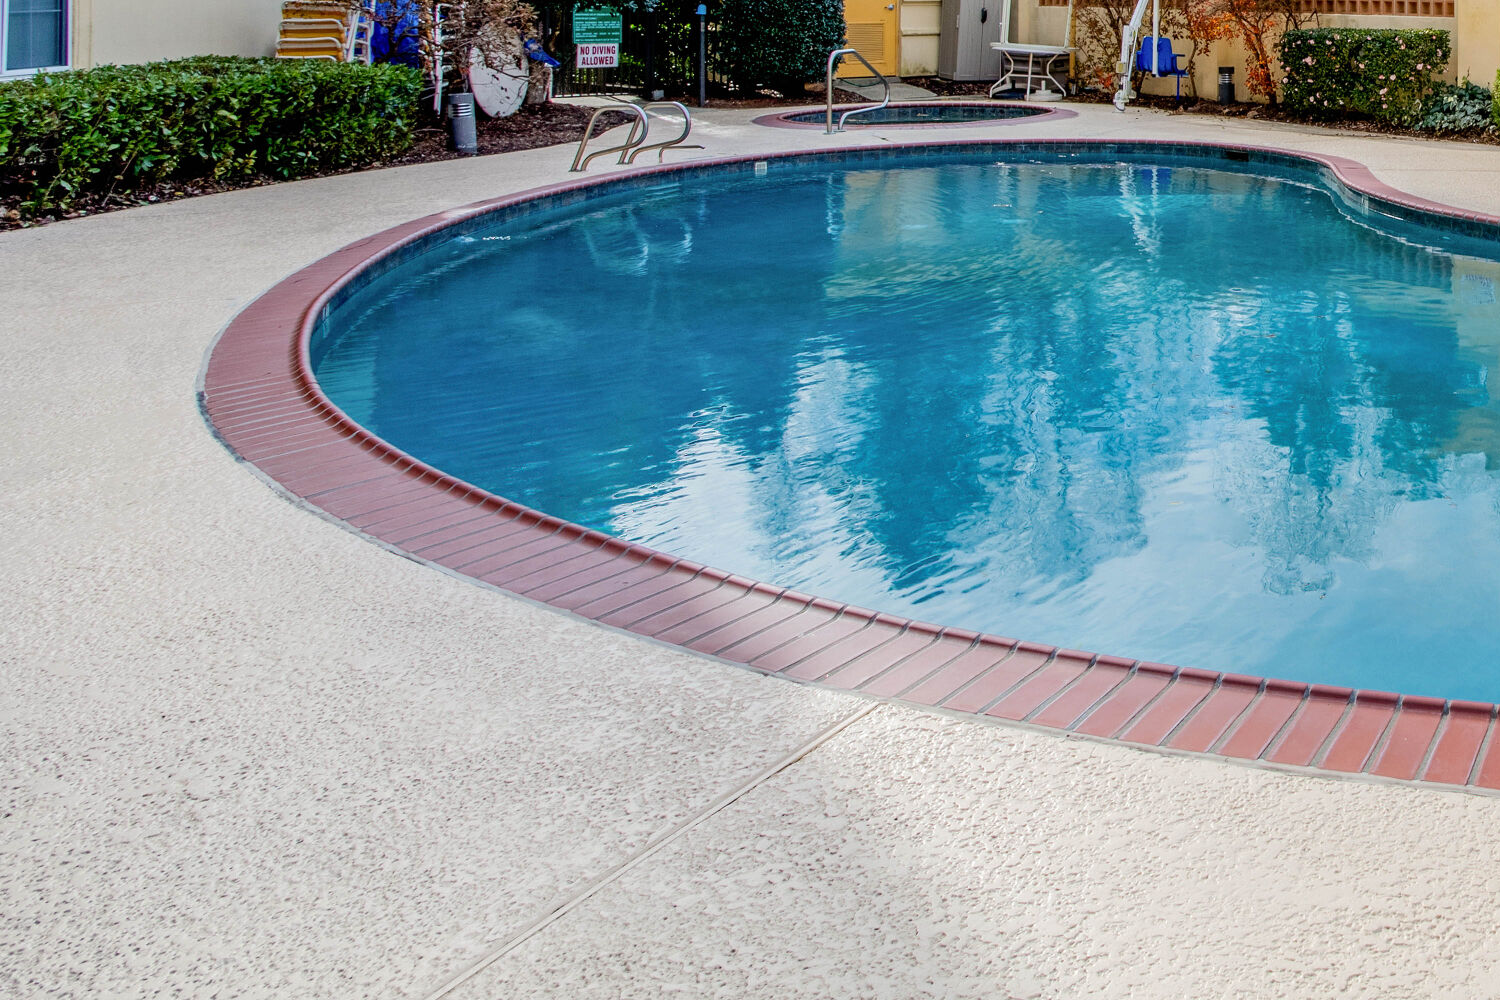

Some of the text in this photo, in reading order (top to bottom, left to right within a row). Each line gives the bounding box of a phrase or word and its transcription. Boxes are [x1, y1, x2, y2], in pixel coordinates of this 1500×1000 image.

[580, 45, 616, 55] NO DIVING
[581, 55, 614, 66] ALLOWED
